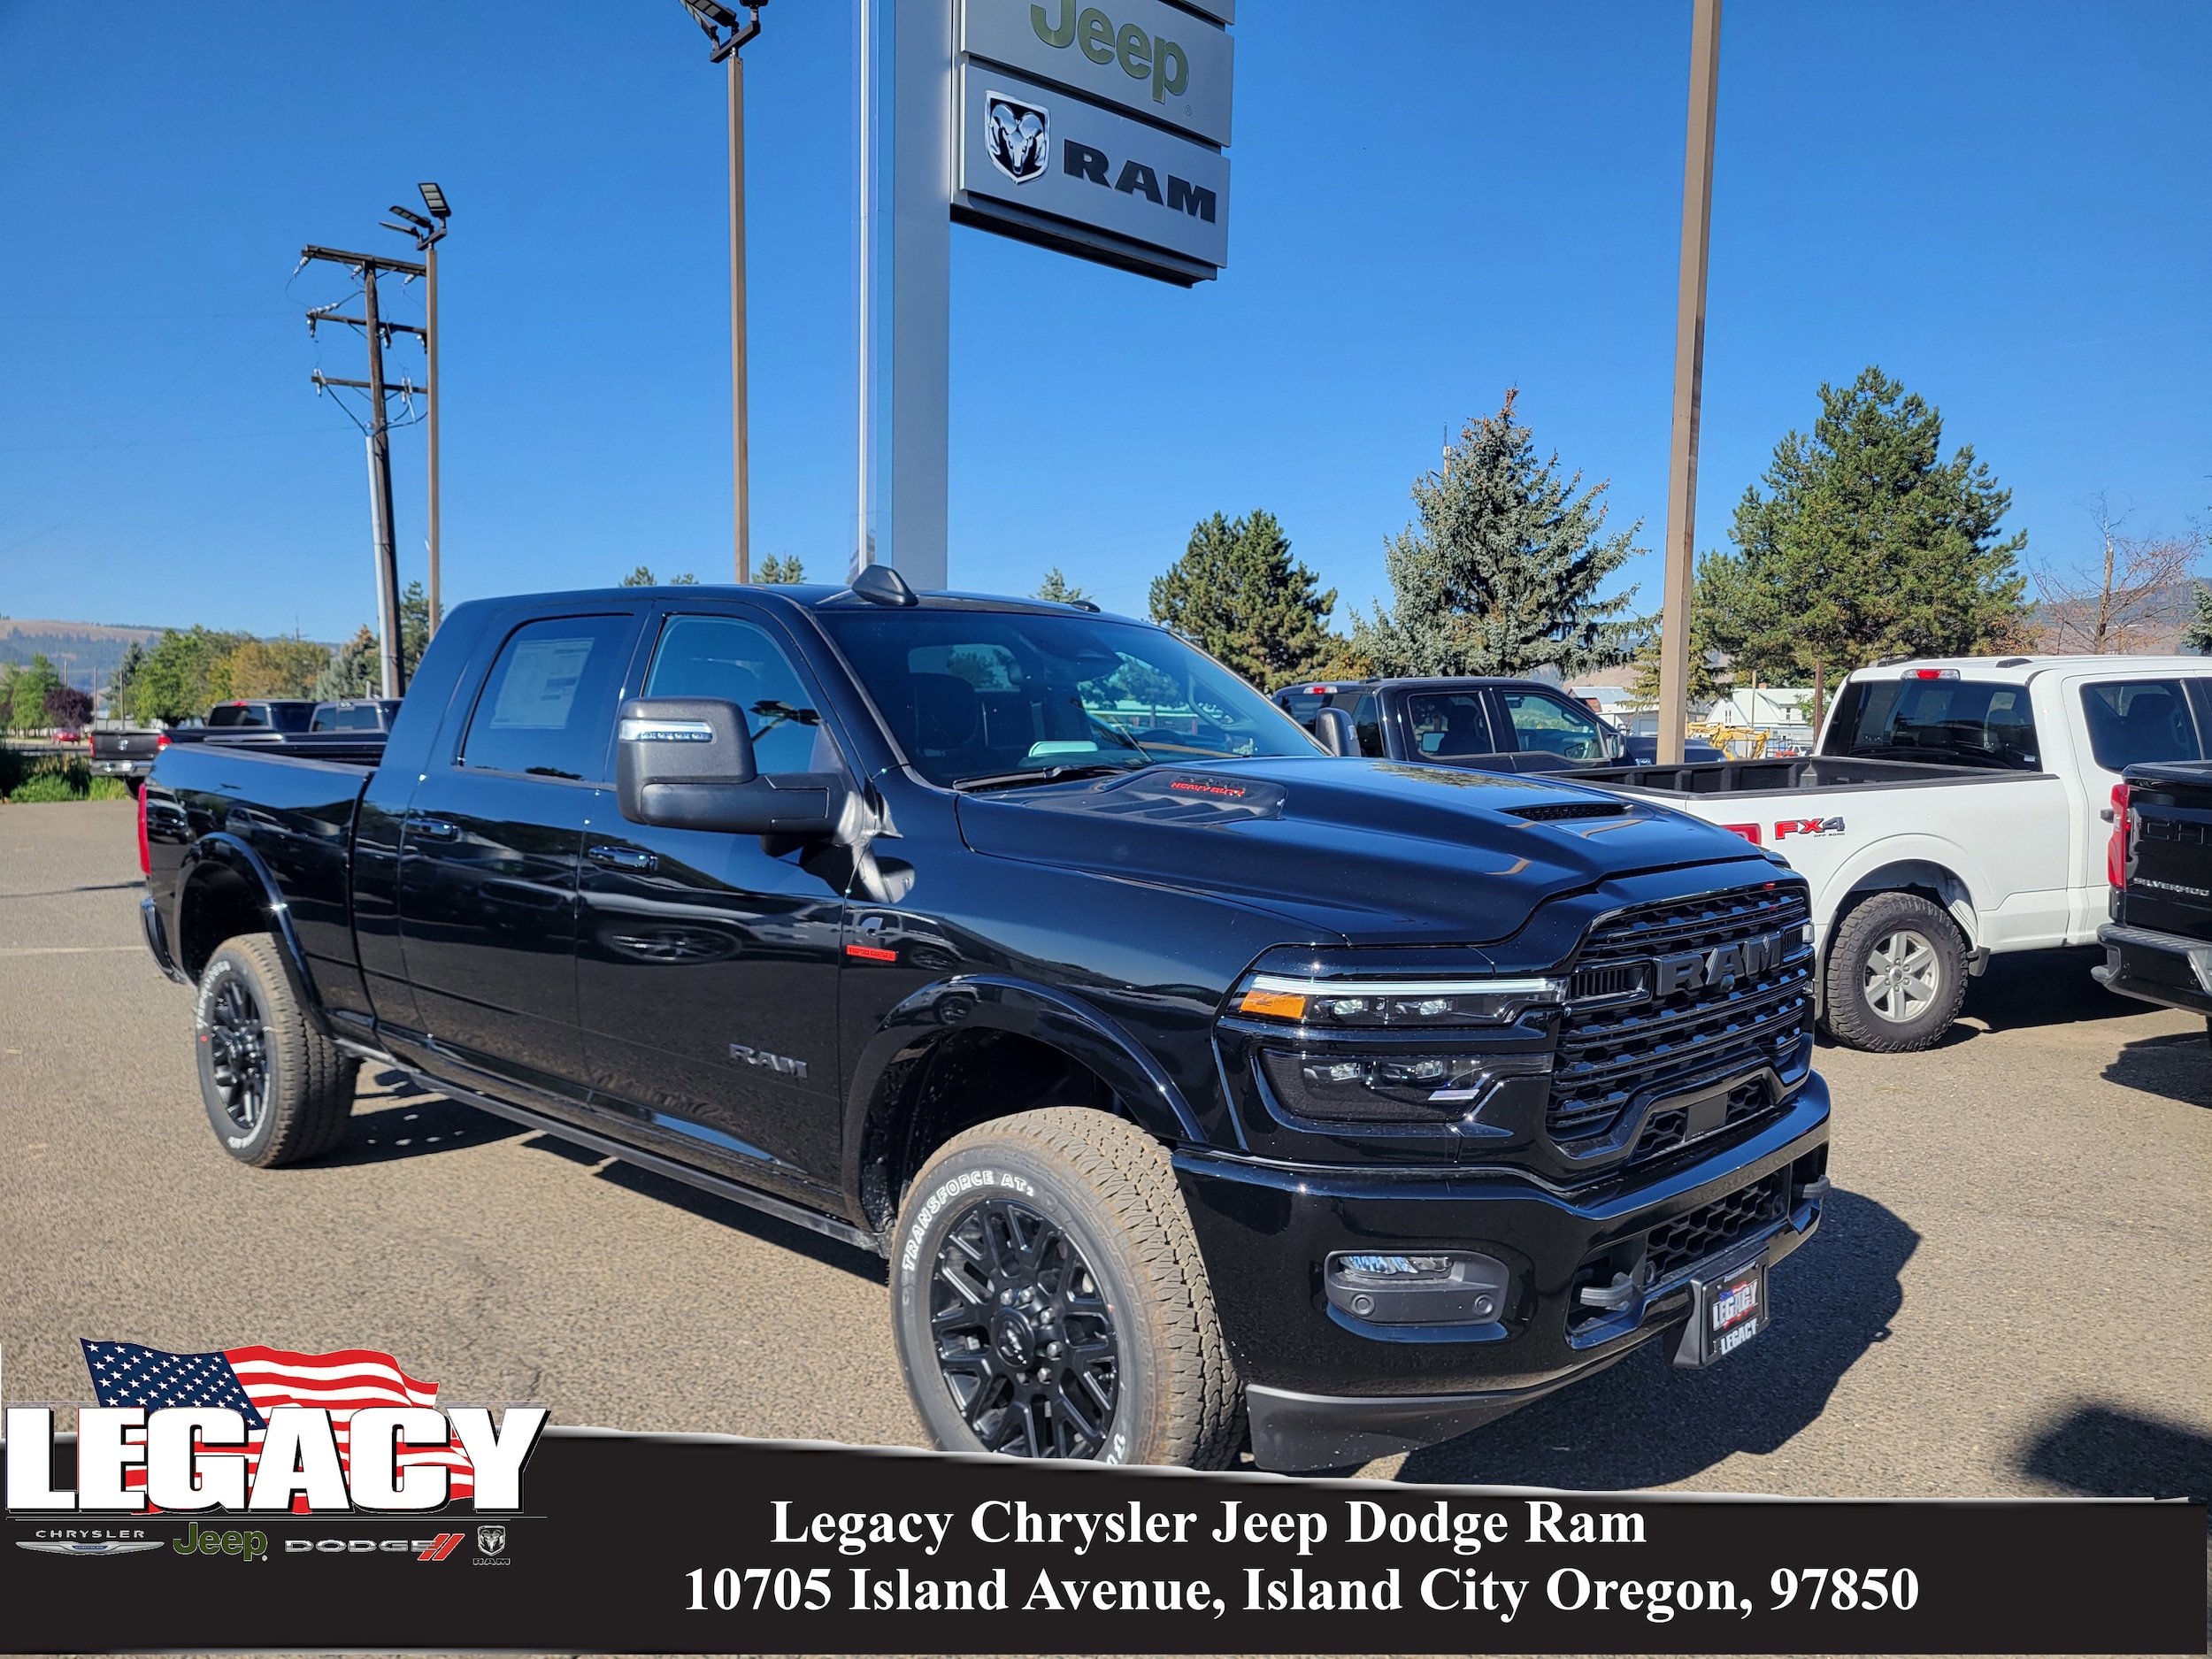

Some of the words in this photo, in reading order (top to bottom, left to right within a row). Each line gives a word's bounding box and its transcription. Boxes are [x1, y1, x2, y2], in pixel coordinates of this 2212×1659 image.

[1030, 0, 1188, 104] Jeep
[1064, 138, 1217, 224] RAM
[1775, 817, 1845, 840] FX4
[2133, 877, 2209, 896] SILVERADO
[1653, 931, 1781, 996] RAM
[729, 1043, 808, 1079] RAM
[901, 1170, 995, 1272] TRANSFORCE
[1713, 1280, 1758, 1330] LEGACY
[1720, 1317, 1757, 1355] LEGACY
